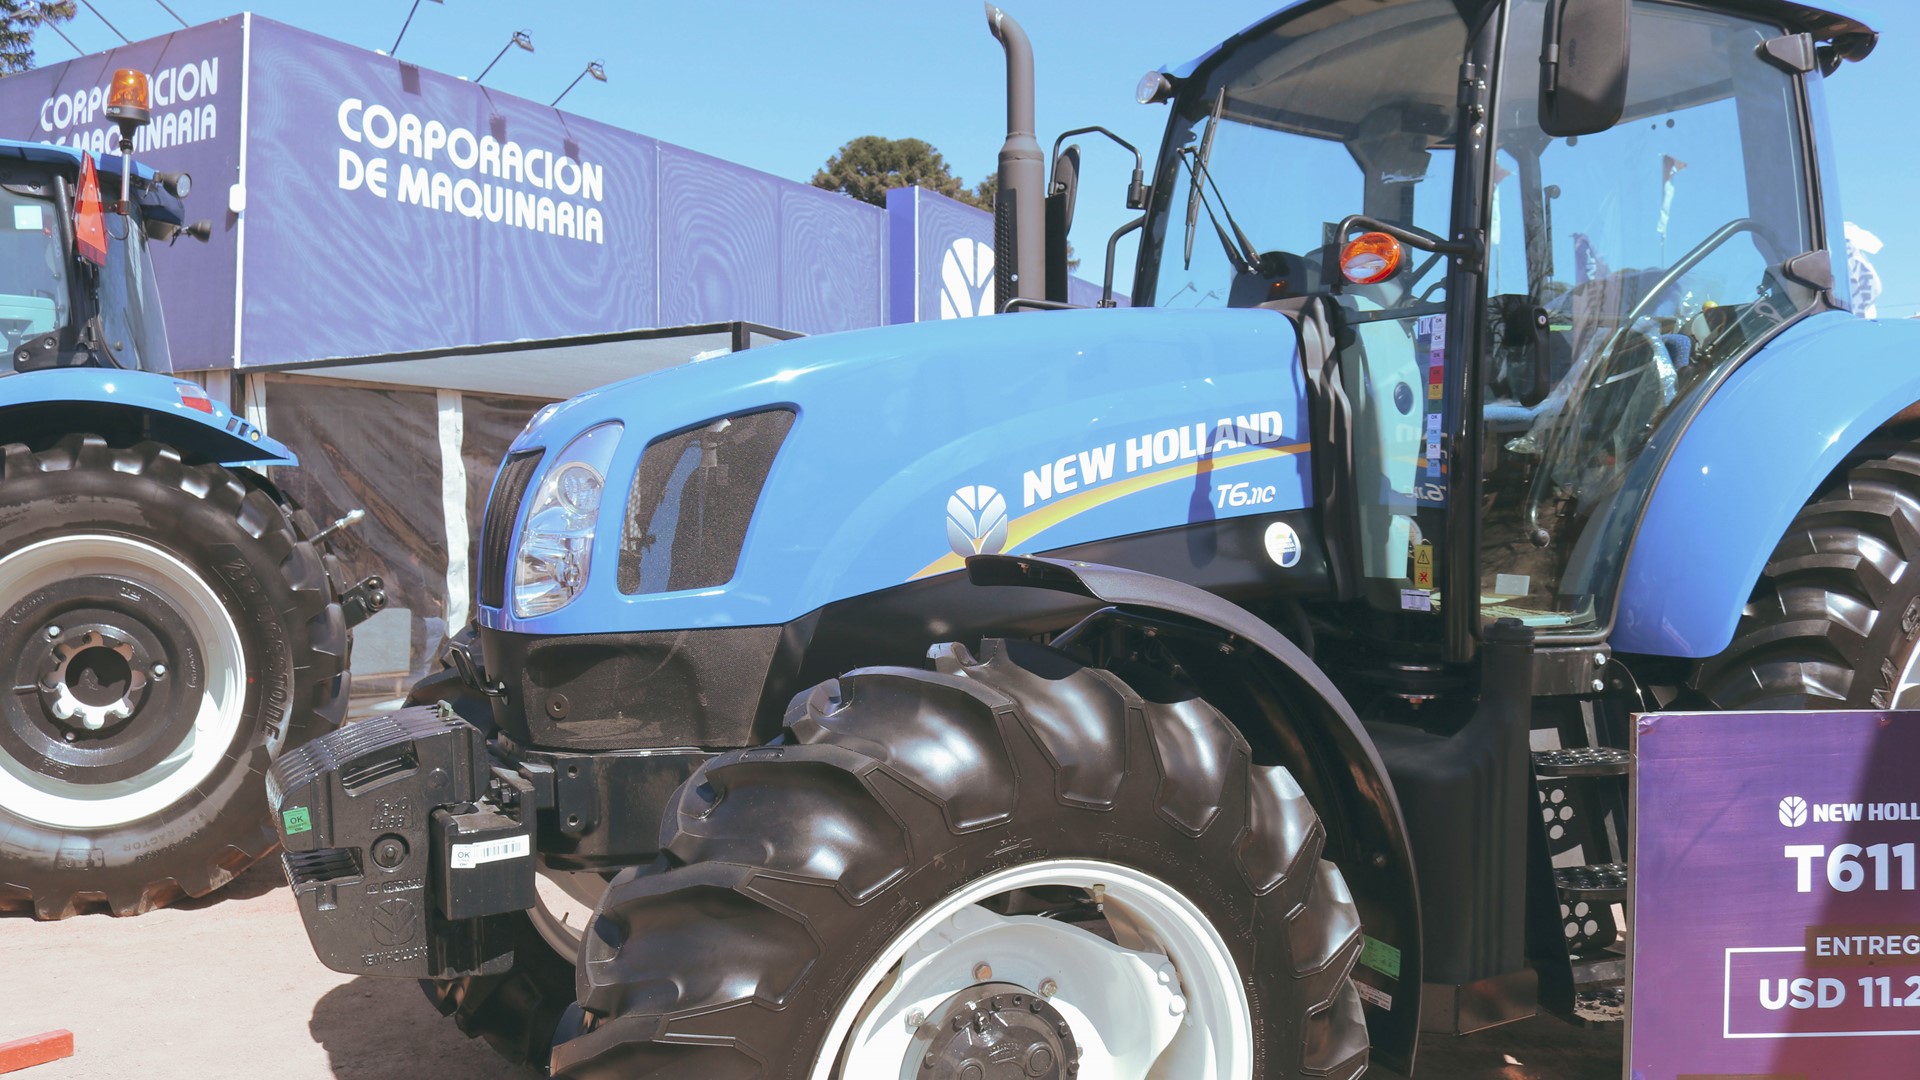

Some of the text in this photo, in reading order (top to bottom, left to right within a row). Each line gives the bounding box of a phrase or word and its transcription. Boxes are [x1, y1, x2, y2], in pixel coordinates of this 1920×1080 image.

[40, 56, 219, 132] CORPCION
[337, 97, 603, 202] CORPORACION
[338, 147, 604, 245] DE MAQUINARIA
[1023, 410, 1284, 508] NEW HOLLAND
[290, 816, 304, 825] OK
[1813, 802, 1920, 823] NEW HOLL
[457, 851, 471, 859] OK
[1784, 843, 1915, 893] T611
[1816, 935, 1920, 957] ENTREG
[1759, 975, 1920, 1010] USD 11.2
